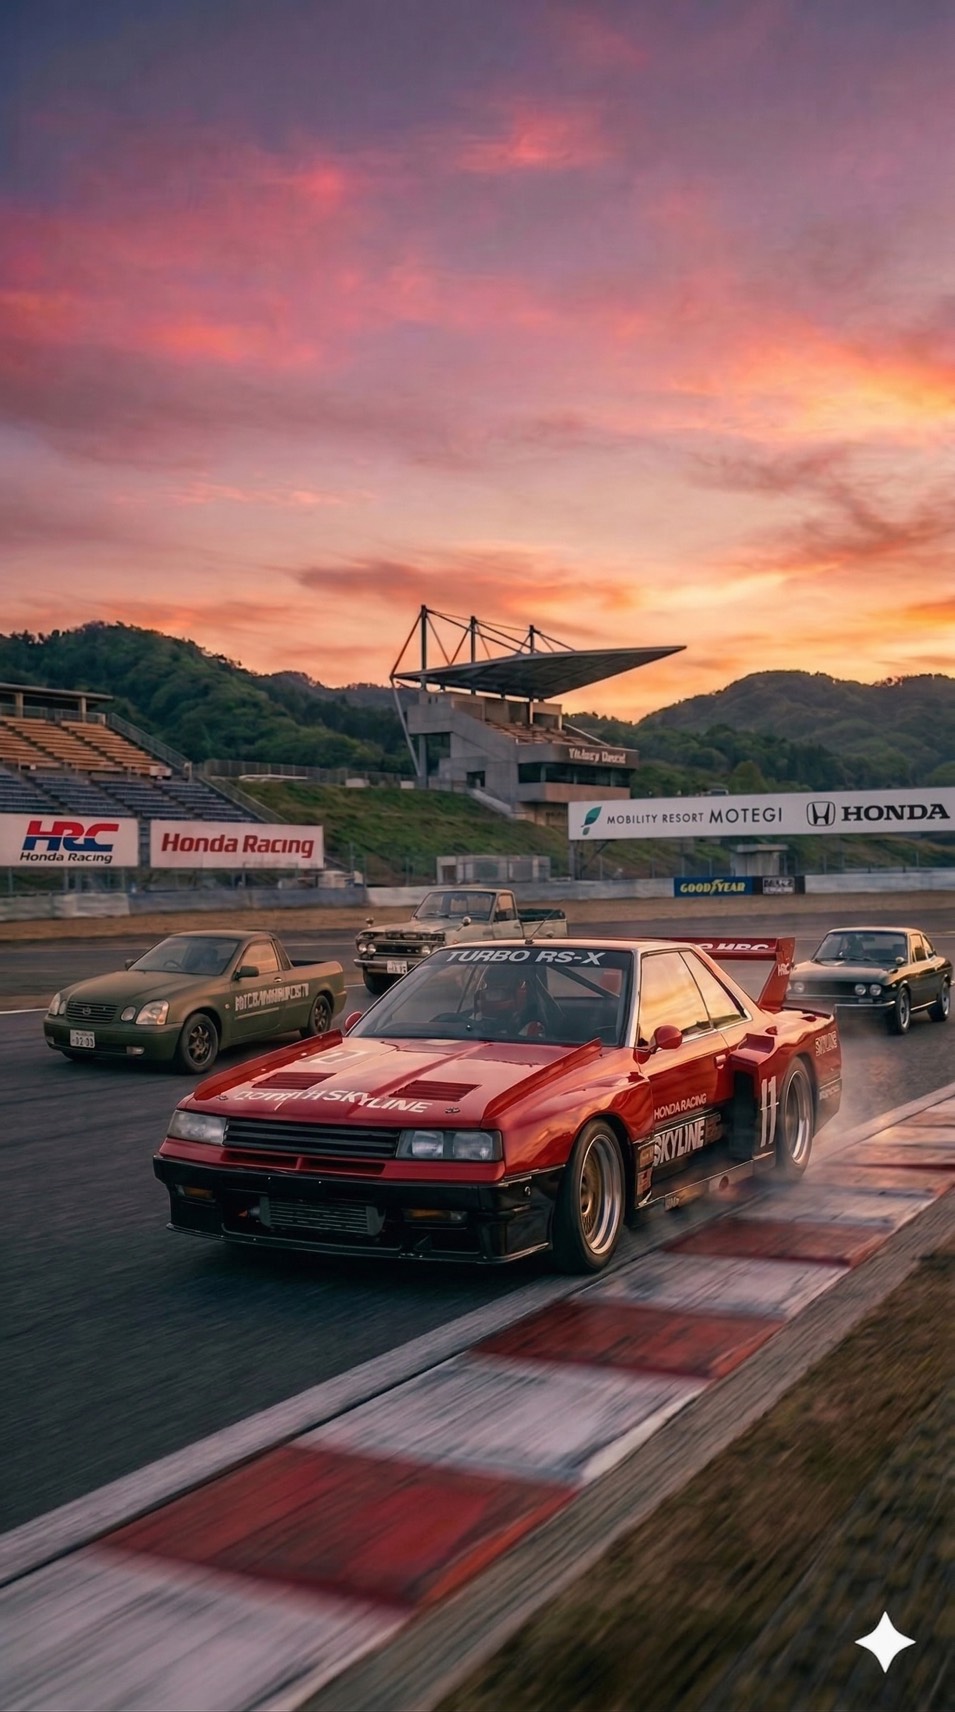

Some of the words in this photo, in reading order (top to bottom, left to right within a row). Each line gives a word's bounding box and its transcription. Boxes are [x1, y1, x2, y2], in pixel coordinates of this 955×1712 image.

[607, 814, 658, 824] MOBILITY
[662, 812, 704, 823] RESORT
[709, 807, 782, 823] MOTEGI
[841, 804, 950, 821] HONDA
[22, 820, 119, 852] HRC
[161, 833, 238, 853] Honda
[242, 835, 314, 858] Racing
[20, 852, 64, 862] Honda
[68, 852, 113, 864] Racing
[680, 879, 746, 895] GOODYEAR
[446, 950, 530, 962] TURBO
[535, 951, 606, 965] RS-X
[654, 1103, 680, 1120] HONDA
[681, 1093, 707, 1111] RACING
[760, 1076, 776, 1148] 11
[652, 1119, 705, 1167] SKYLINE
